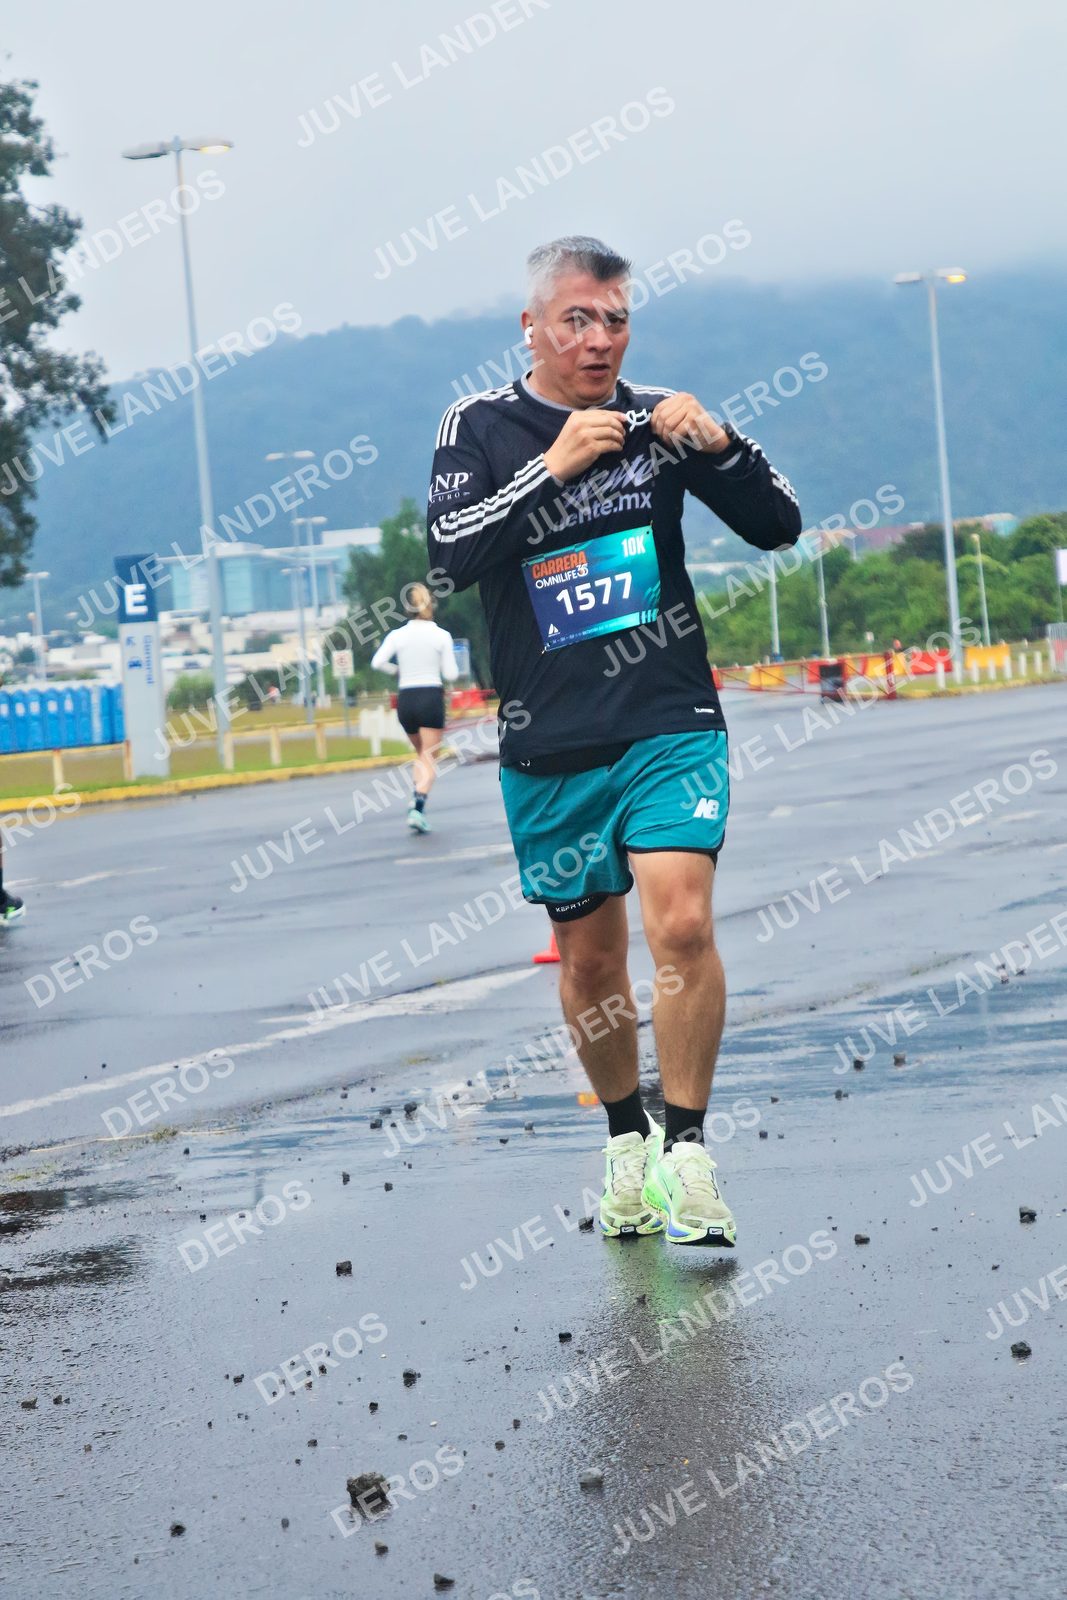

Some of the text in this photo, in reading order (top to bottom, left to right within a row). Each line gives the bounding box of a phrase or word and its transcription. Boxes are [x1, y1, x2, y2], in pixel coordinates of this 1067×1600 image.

[621, 535, 647, 557] 10K
[532, 551, 588, 579] CARRERA
[125, 583, 148, 615] E
[556, 571, 632, 615] 1577
